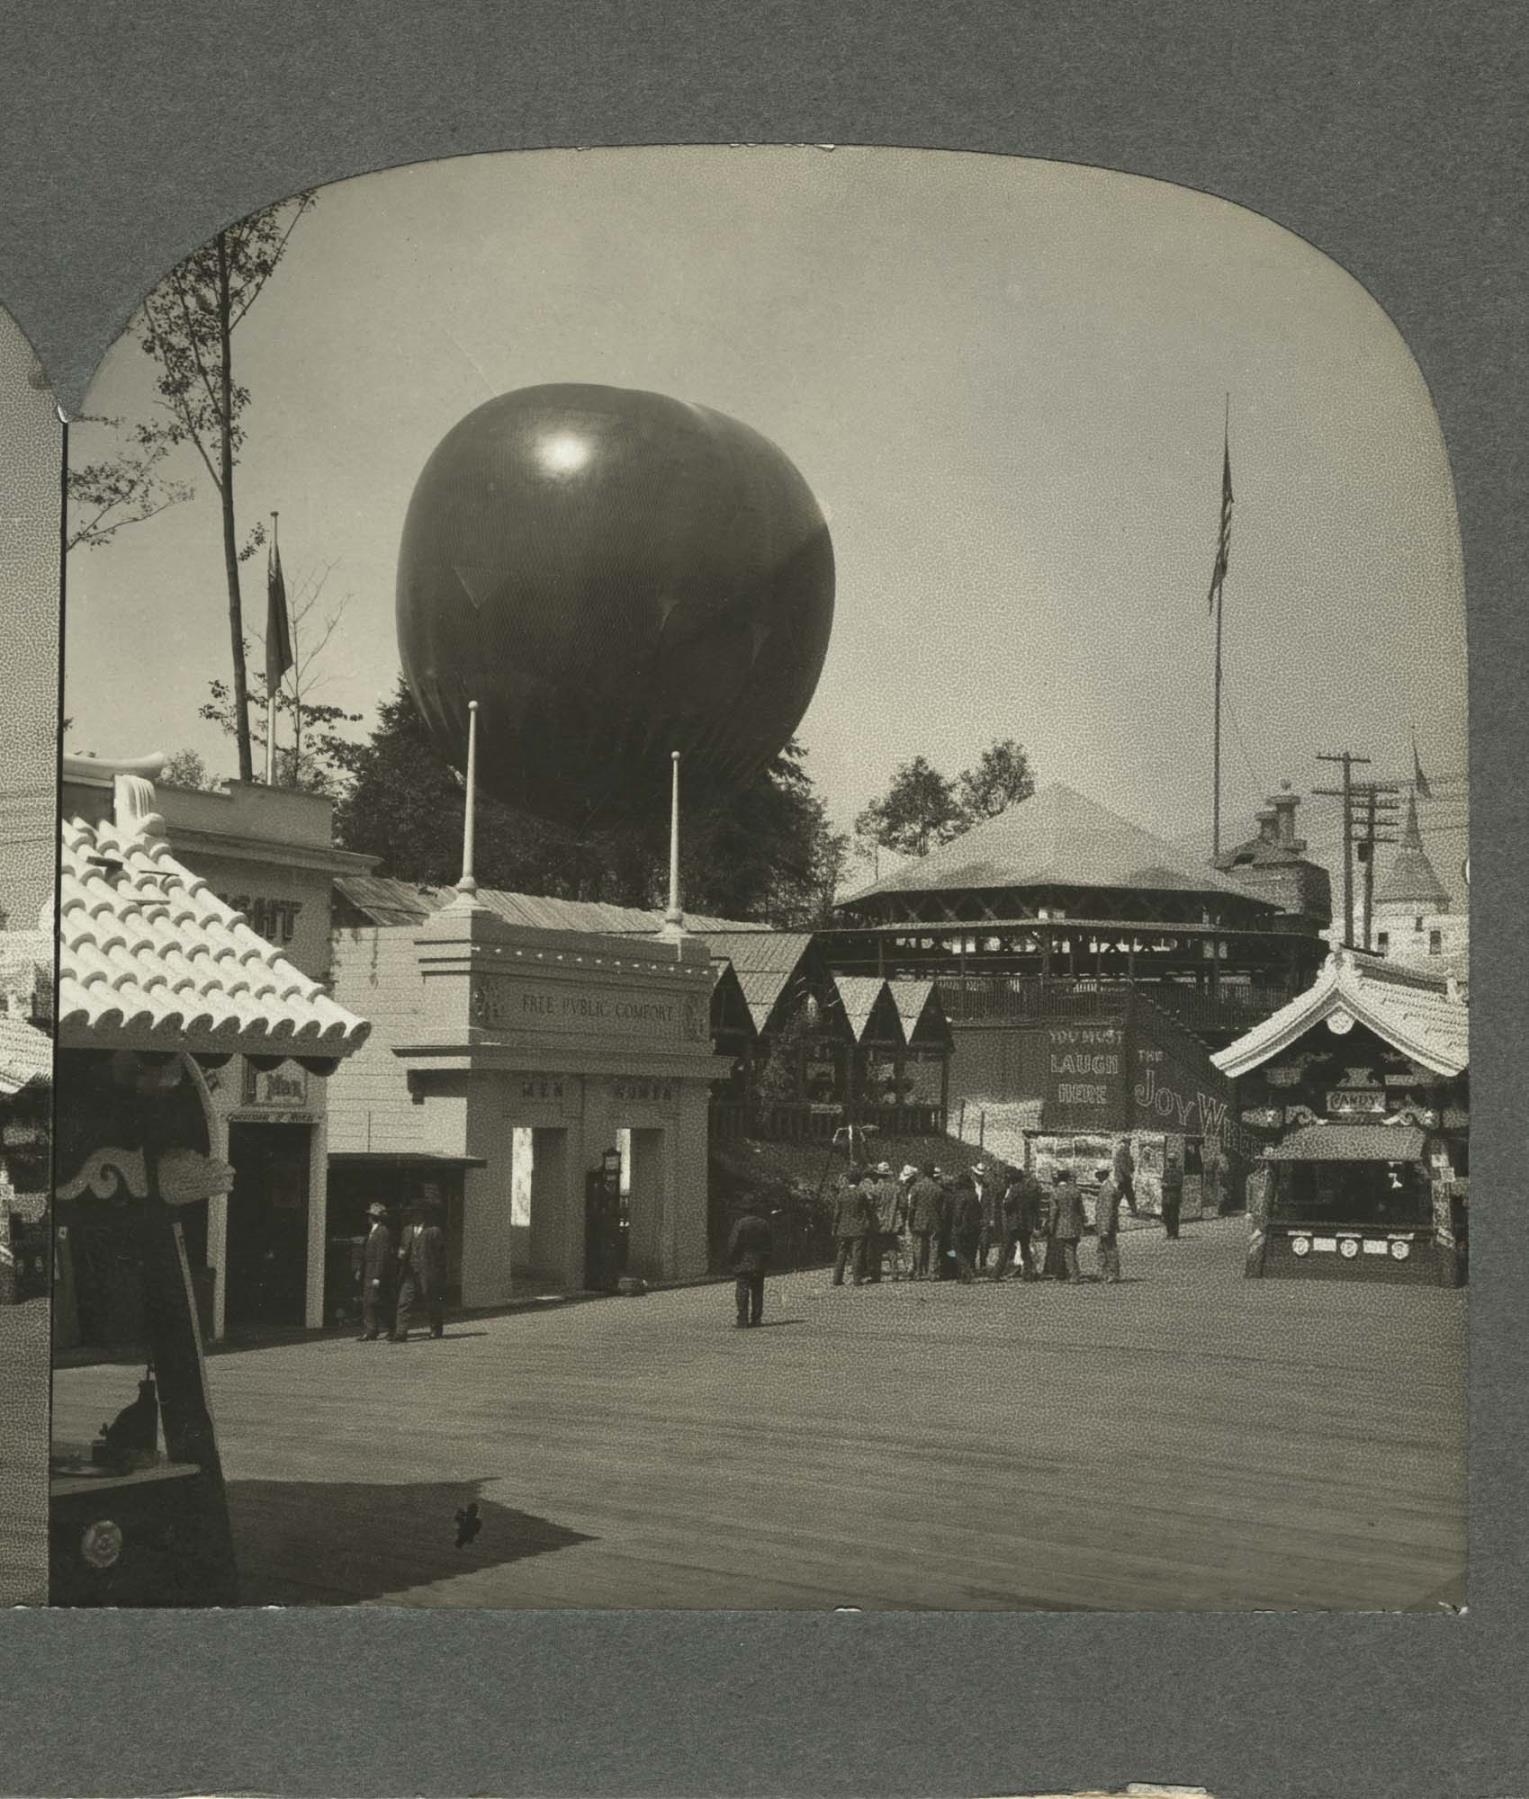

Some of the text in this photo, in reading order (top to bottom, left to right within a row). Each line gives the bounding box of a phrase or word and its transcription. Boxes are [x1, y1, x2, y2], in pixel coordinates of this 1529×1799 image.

[522, 993, 554, 1014] FREE
[615, 1001, 673, 1022] COMFORT
[1048, 1028, 1125, 1045] YOU MUST
[1050, 1053, 1119, 1075] LAUGH
[1137, 1049, 1165, 1063] THE
[1058, 1083, 1108, 1105] HERE
[1134, 1068, 1196, 1127] JOY
[1330, 1092, 1379, 1110] CANDY
